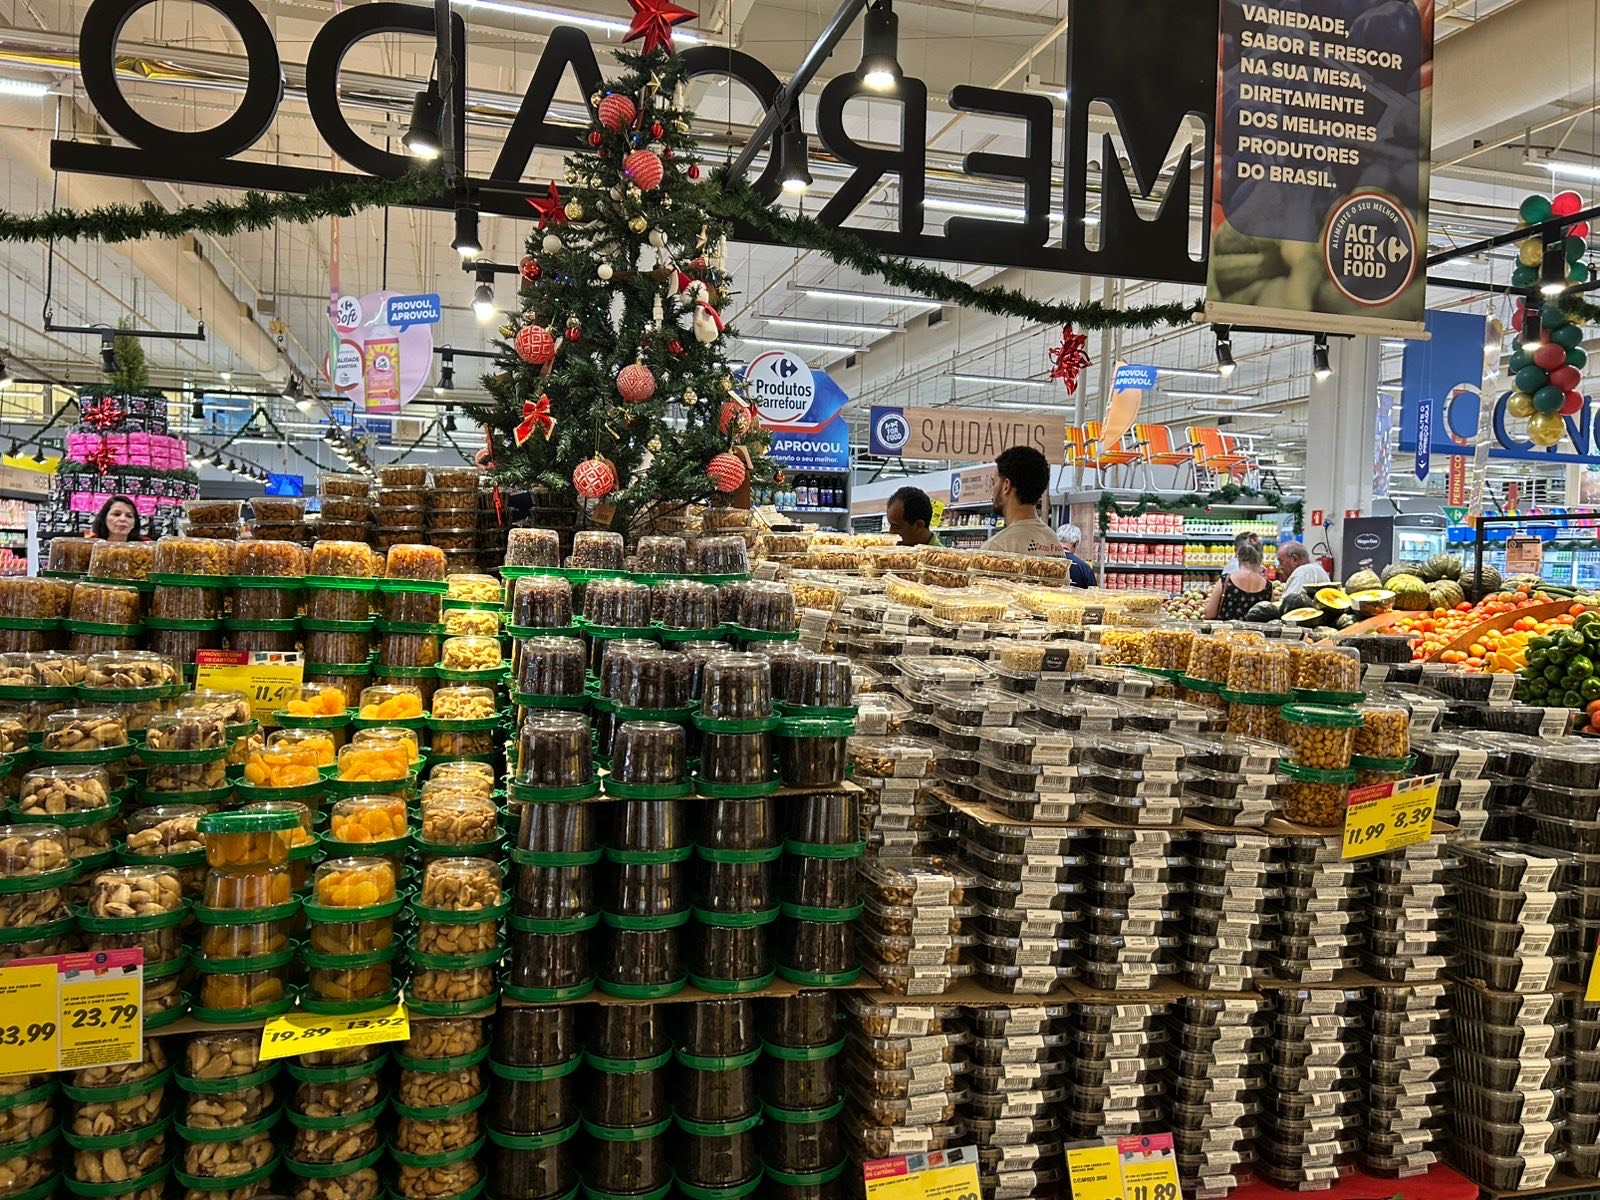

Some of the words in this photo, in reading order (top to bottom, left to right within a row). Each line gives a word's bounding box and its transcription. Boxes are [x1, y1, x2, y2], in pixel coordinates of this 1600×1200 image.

[1242, 4, 1350, 38] VARIEDADE,
[1241, 32, 1304, 55] SABOR
[1309, 40, 1319, 57] E
[1324, 43, 1402, 70] FRESCOR
[1240, 58, 1268, 76] NA
[1272, 62, 1308, 82] SUA
[1314, 67, 1367, 92] MESA,
[1240, 83, 1364, 116] DIRETAMENTE
[1239, 110, 1278, 129] DOS
[1282, 115, 1377, 142] MELHORES
[1238, 136, 1360, 165] PRODUTORES
[1237, 162, 1264, 180] DO
[1270, 165, 1337, 189] BRASIL.
[1332, 211, 1352, 248] ALIMENTE
[1352, 206, 1357, 214] O
[1358, 202, 1370, 211] SEU
[1373, 203, 1399, 224] MELHOR
[1345, 224, 1377, 244] ACT
[1344, 243, 1375, 260] FOR
[1344, 260, 1386, 278] FOOD
[391, 300, 432, 311] PROVOU,
[391, 310, 438, 321] APROVOU.
[756, 380, 812, 397] Produtos
[757, 395, 806, 410] Carrefour
[775, 440, 843, 453] APROVOU.
[922, 418, 1045, 455] SAUDÁVEIS
[1453, 455, 1462, 504] PERNIL/CO
[256, 686, 287, 702] 11,4
[1394, 806, 1432, 828] 8,39
[1348, 823, 1385, 845] 11,99
[72, 1004, 138, 1028] 23,79
[348, 1018, 404, 1030] 13,92
[271, 1027, 331, 1042] 19,89
